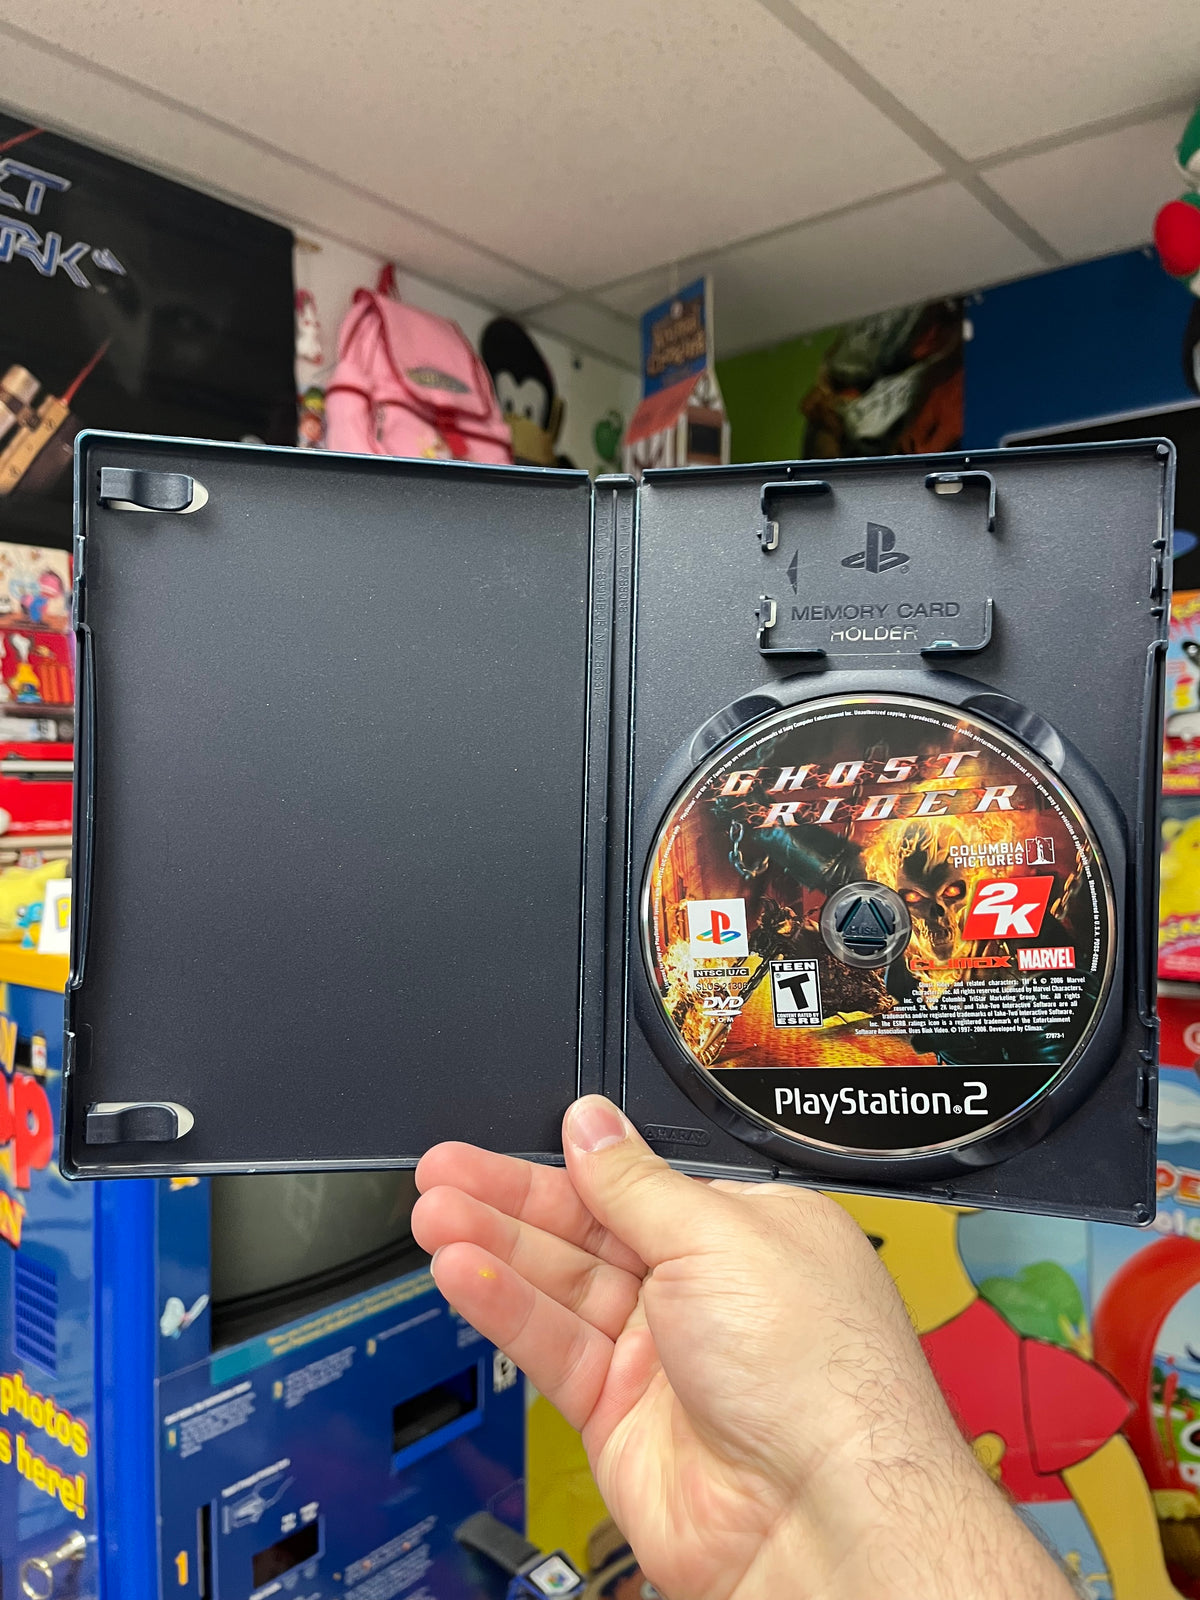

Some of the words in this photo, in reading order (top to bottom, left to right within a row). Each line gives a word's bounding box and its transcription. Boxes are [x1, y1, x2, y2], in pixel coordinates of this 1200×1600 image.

[791, 604, 890, 621] MEMORY
[897, 602, 961, 619] CARD
[830, 624, 919, 642] HOLDER
[720, 750, 981, 796] GHOST
[753, 785, 1018, 829] RIDER
[949, 841, 1025, 858] COLUMBIA
[953, 853, 1024, 869] PICTURES
[972, 881, 1041, 937] 2K
[771, 961, 816, 971] TEEN
[1018, 948, 1074, 969] MARVEL
[695, 982, 721, 991] SLUS
[777, 973, 810, 1010] T
[703, 996, 744, 1010] DVD
[776, 1017, 820, 1025] ESRB
[0, 1372, 91, 1458] photos
[16, 1433, 88, 1520] here!
[175, 1551, 189, 1586] 1
